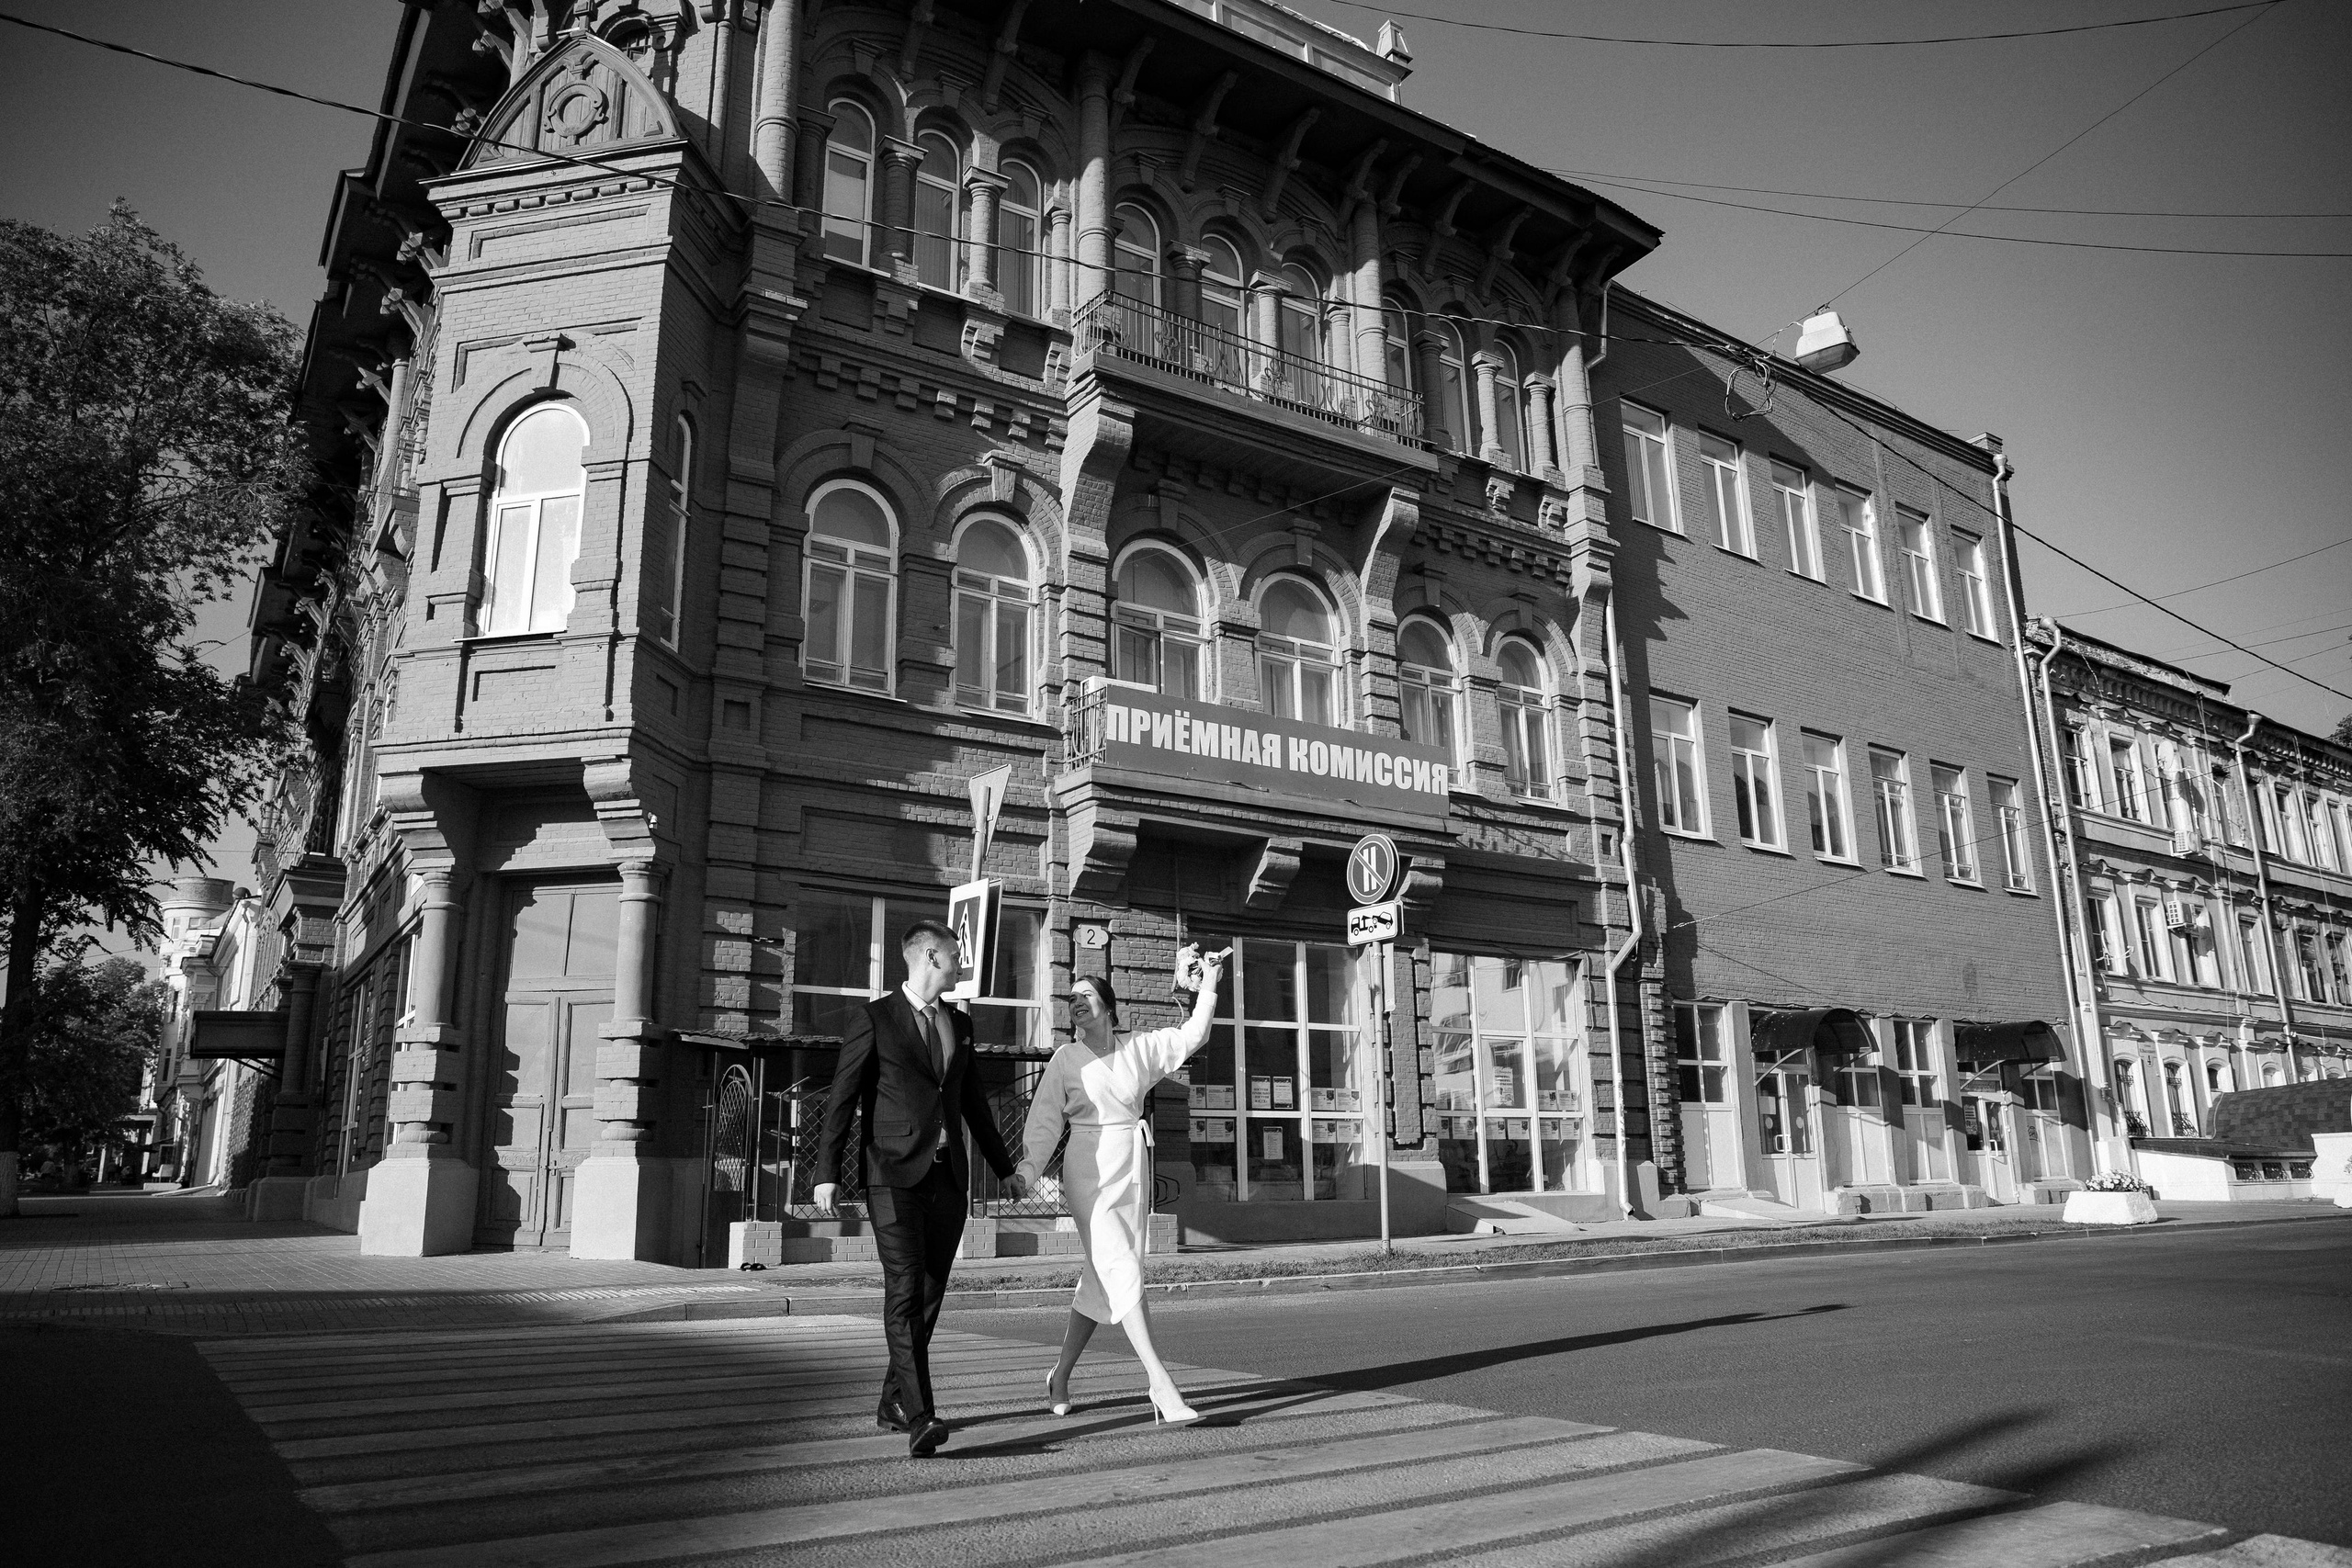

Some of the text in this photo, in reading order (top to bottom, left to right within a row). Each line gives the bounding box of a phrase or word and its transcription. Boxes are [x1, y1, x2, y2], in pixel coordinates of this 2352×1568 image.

[1107, 704, 1449, 796] ПРИЁМНАЯ КОМИССИЯ
[1087, 929, 1096, 944] 2
